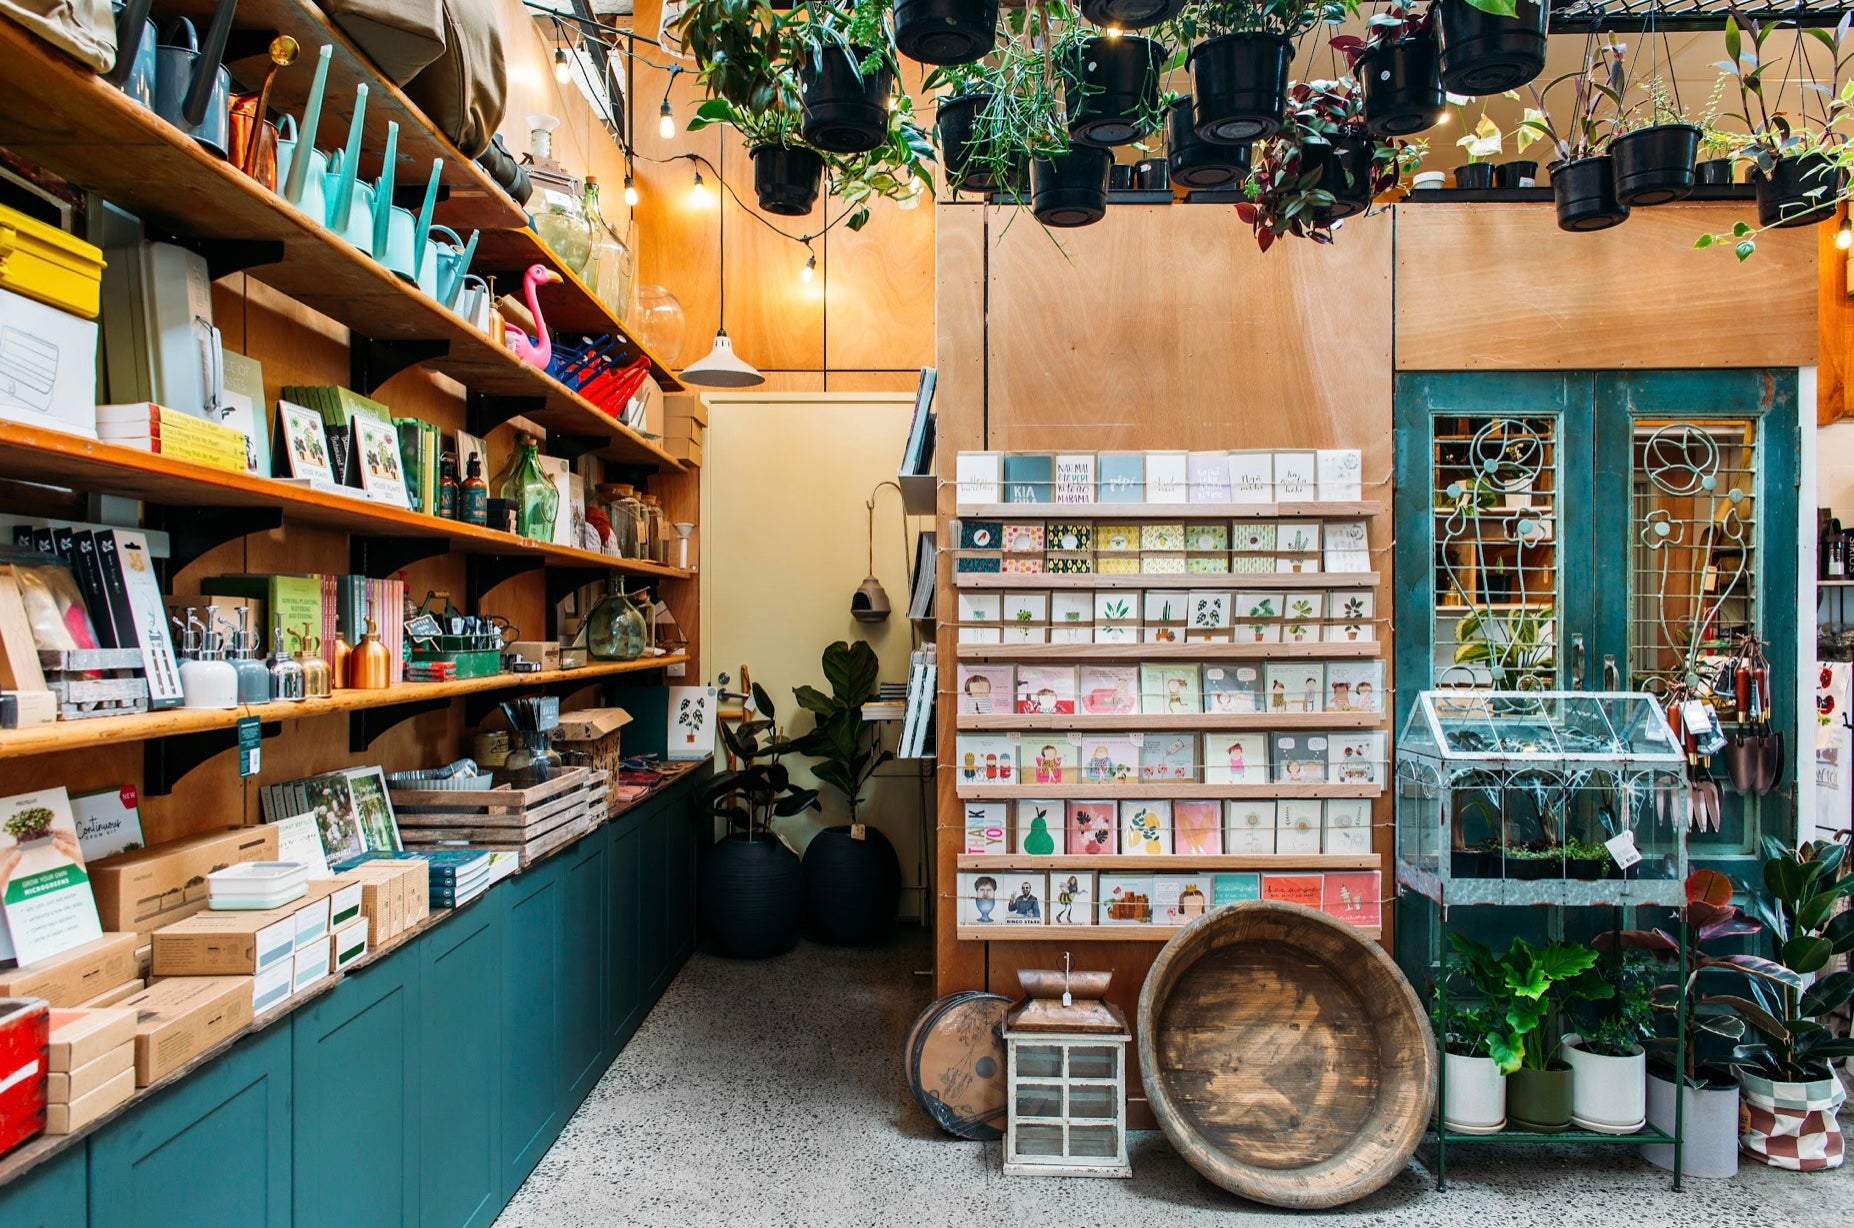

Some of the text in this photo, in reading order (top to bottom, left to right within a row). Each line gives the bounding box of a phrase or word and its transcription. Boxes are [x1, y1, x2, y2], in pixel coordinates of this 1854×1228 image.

[1013, 485, 1036, 498] KIA
[122, 791, 136, 800] NEW
[76, 816, 122, 840] Continuous
[968, 810, 985, 854] THANK
[986, 819, 1003, 846] YOU
[22, 878, 38, 888] GROW
[40, 874, 54, 883] YOUR
[24, 878, 70, 896] MICROGREENS
